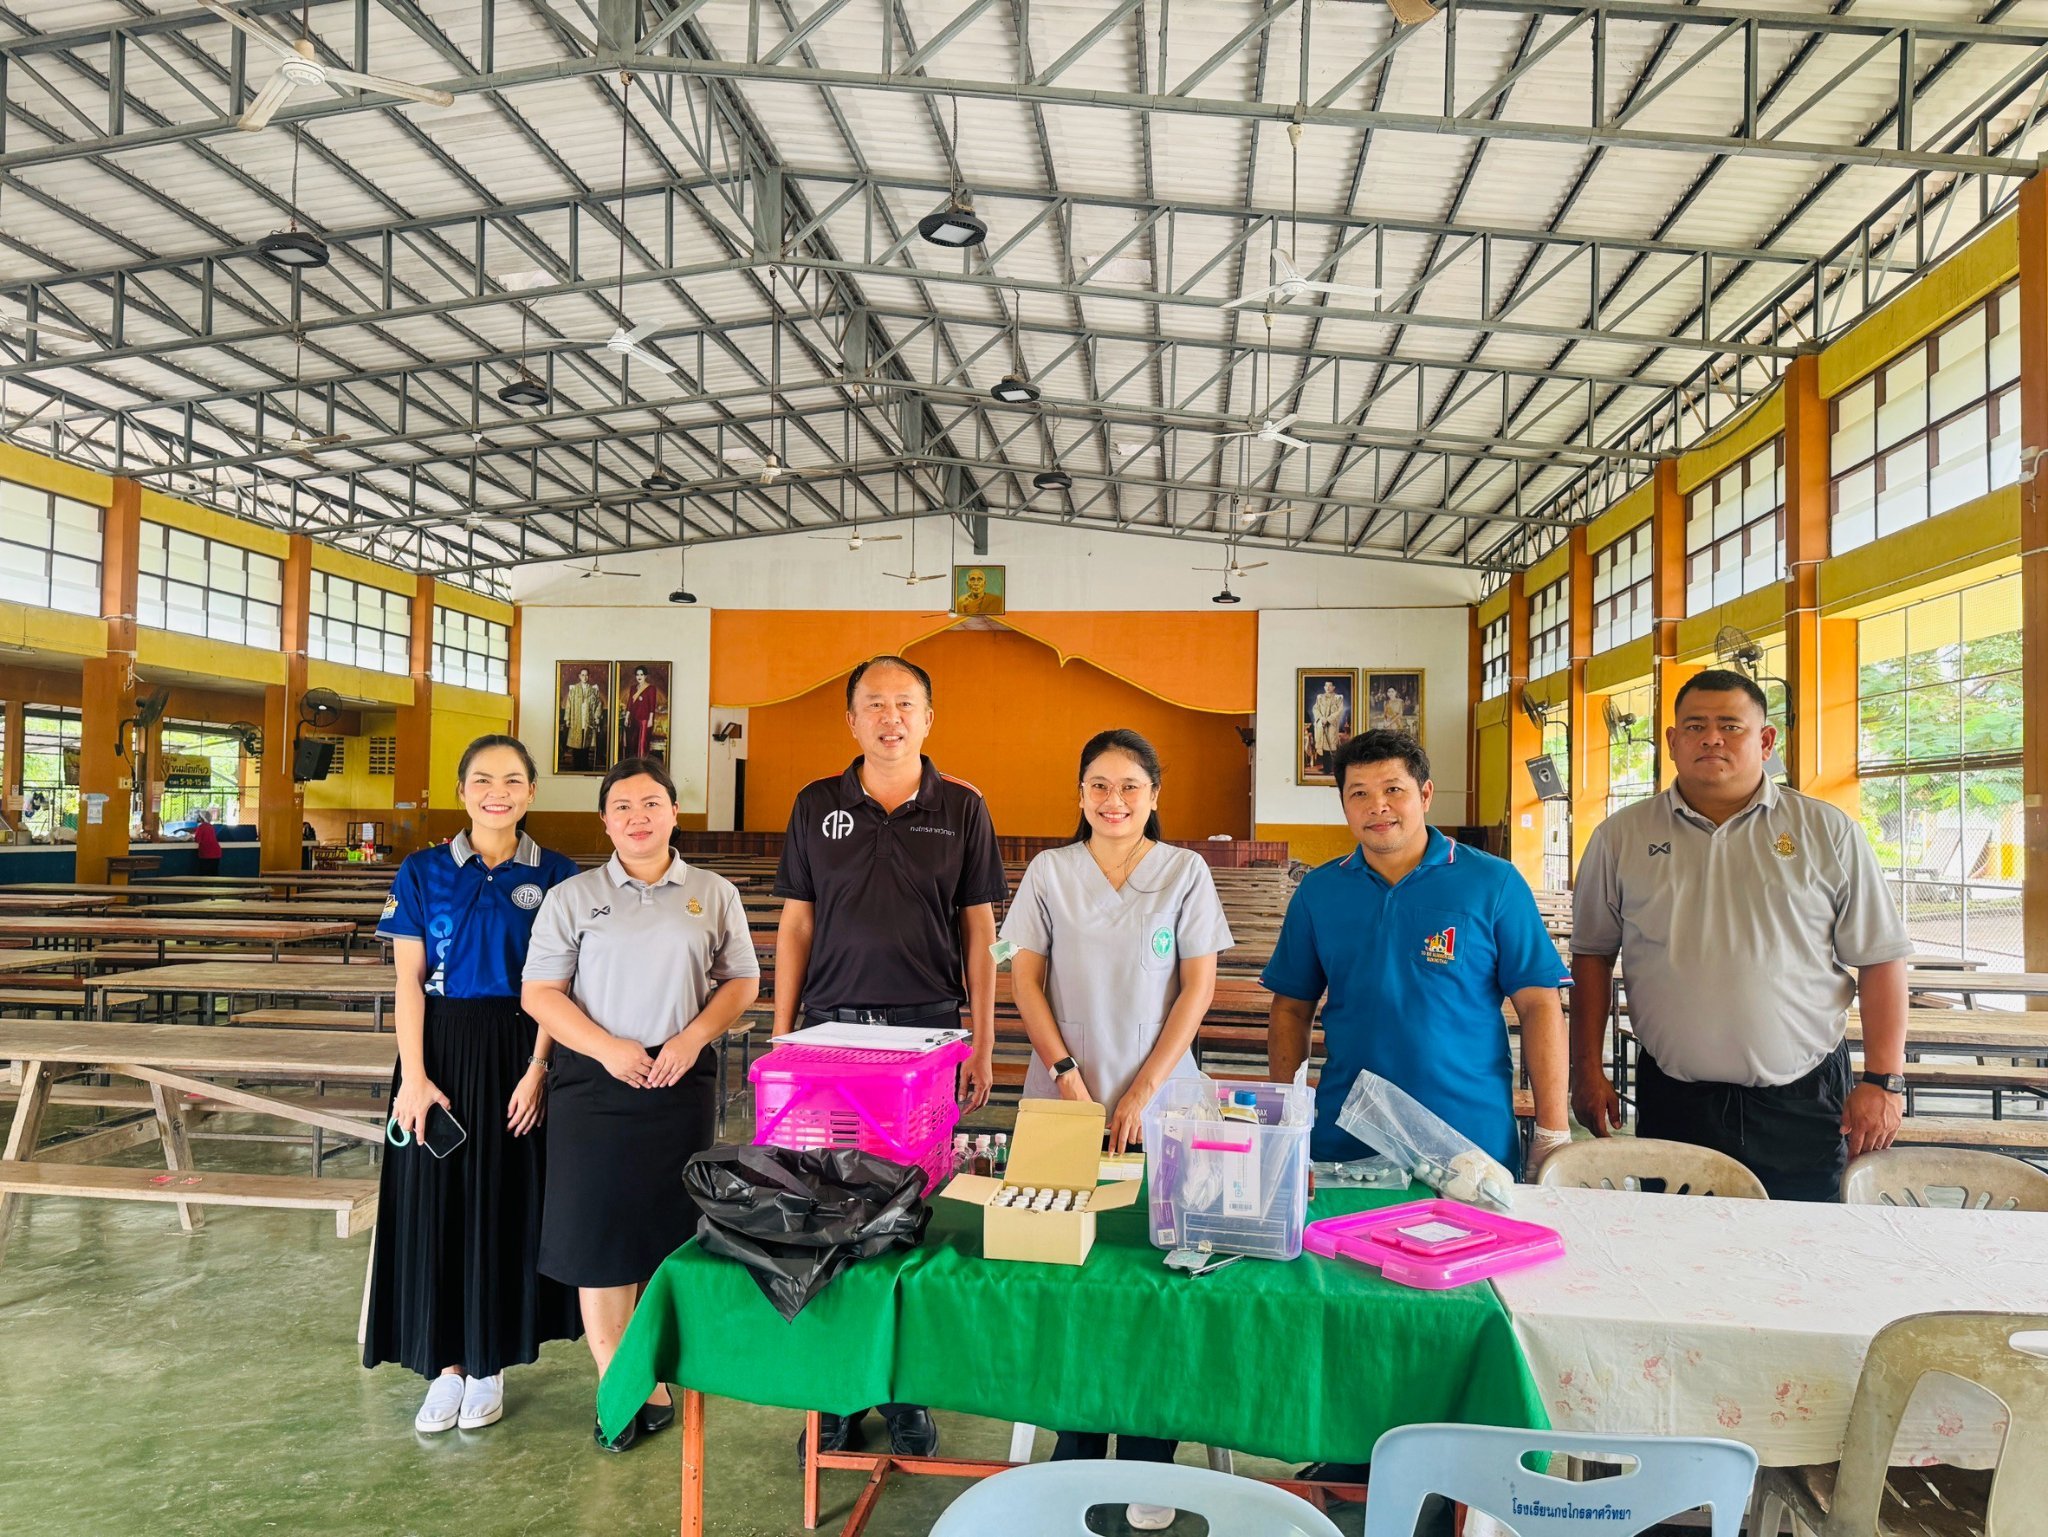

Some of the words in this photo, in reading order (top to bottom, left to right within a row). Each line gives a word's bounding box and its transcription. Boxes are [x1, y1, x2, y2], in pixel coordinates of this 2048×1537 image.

[1512, 1498, 1631, 1520] โรงเรียนกงไกรลาศวิทยา
